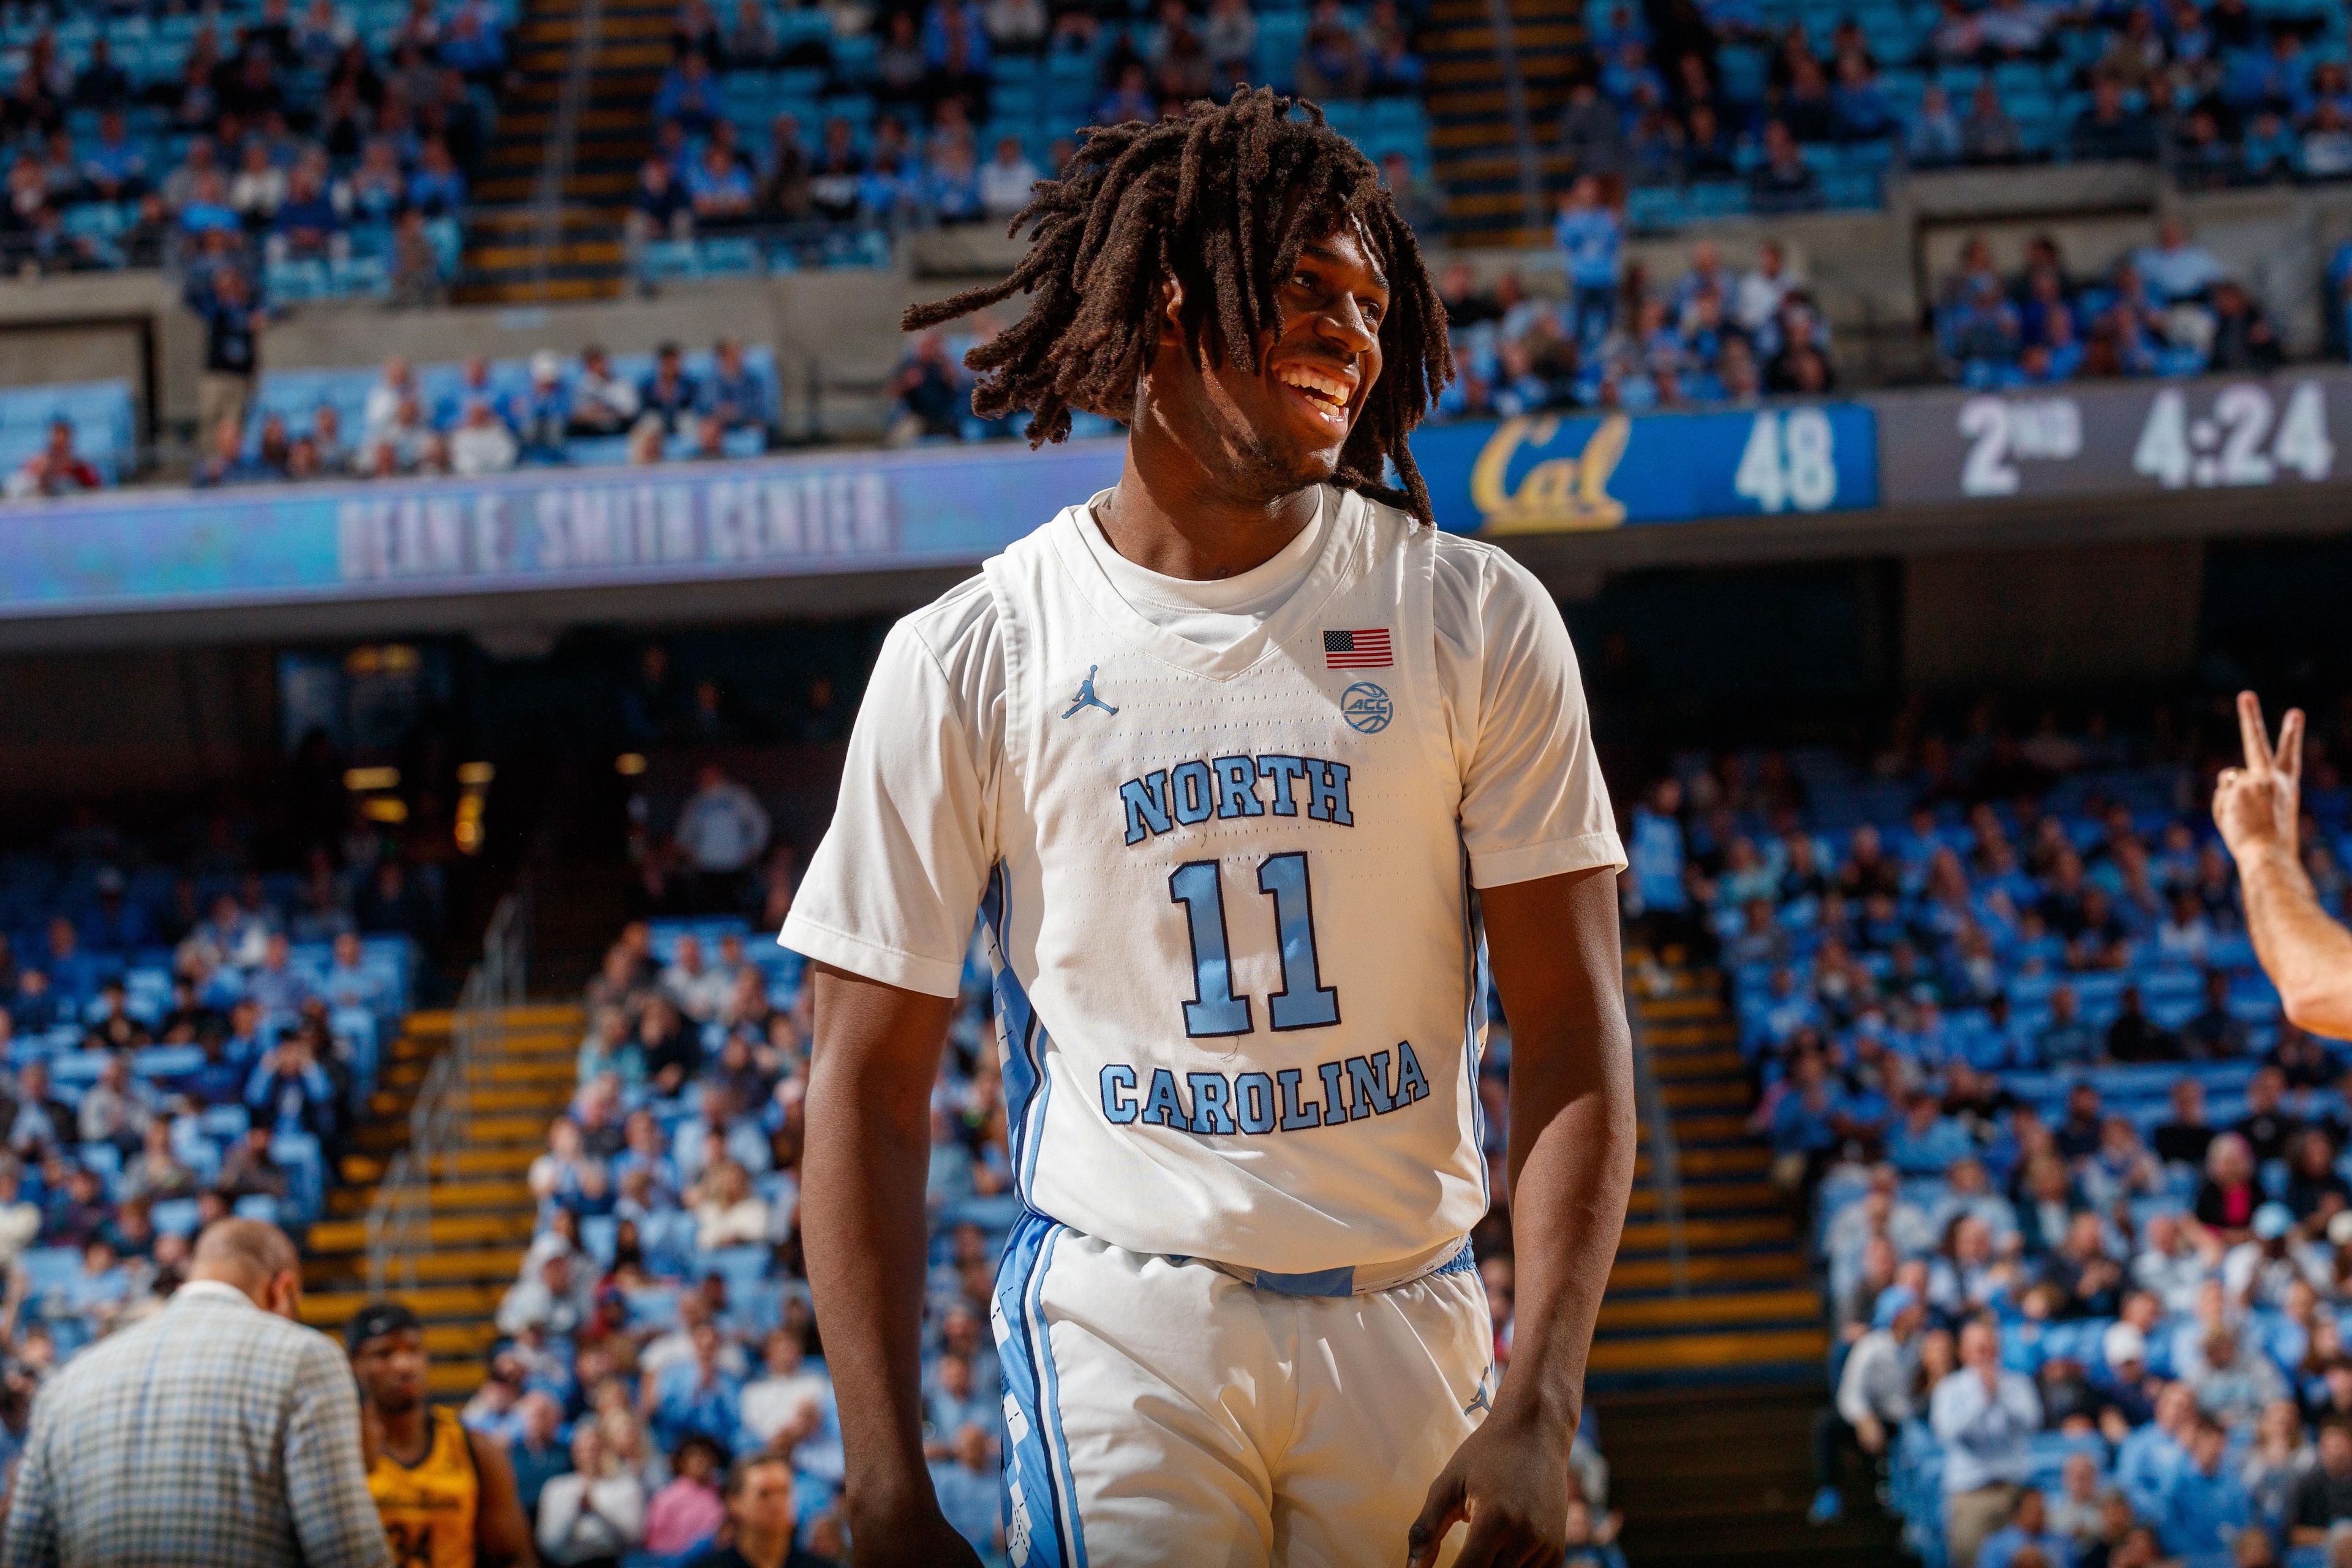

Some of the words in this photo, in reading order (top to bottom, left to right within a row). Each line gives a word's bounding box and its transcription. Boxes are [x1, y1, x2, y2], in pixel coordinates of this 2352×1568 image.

[1471, 413, 1632, 535] Cal
[1735, 407, 1837, 513] 48
[2133, 379, 2335, 489] 4:24
[1347, 698, 1390, 710] ACC
[1120, 754, 1354, 846] NORTH
[1167, 851, 1341, 1038] 11
[1099, 1039, 1430, 1135] CAROLINA
